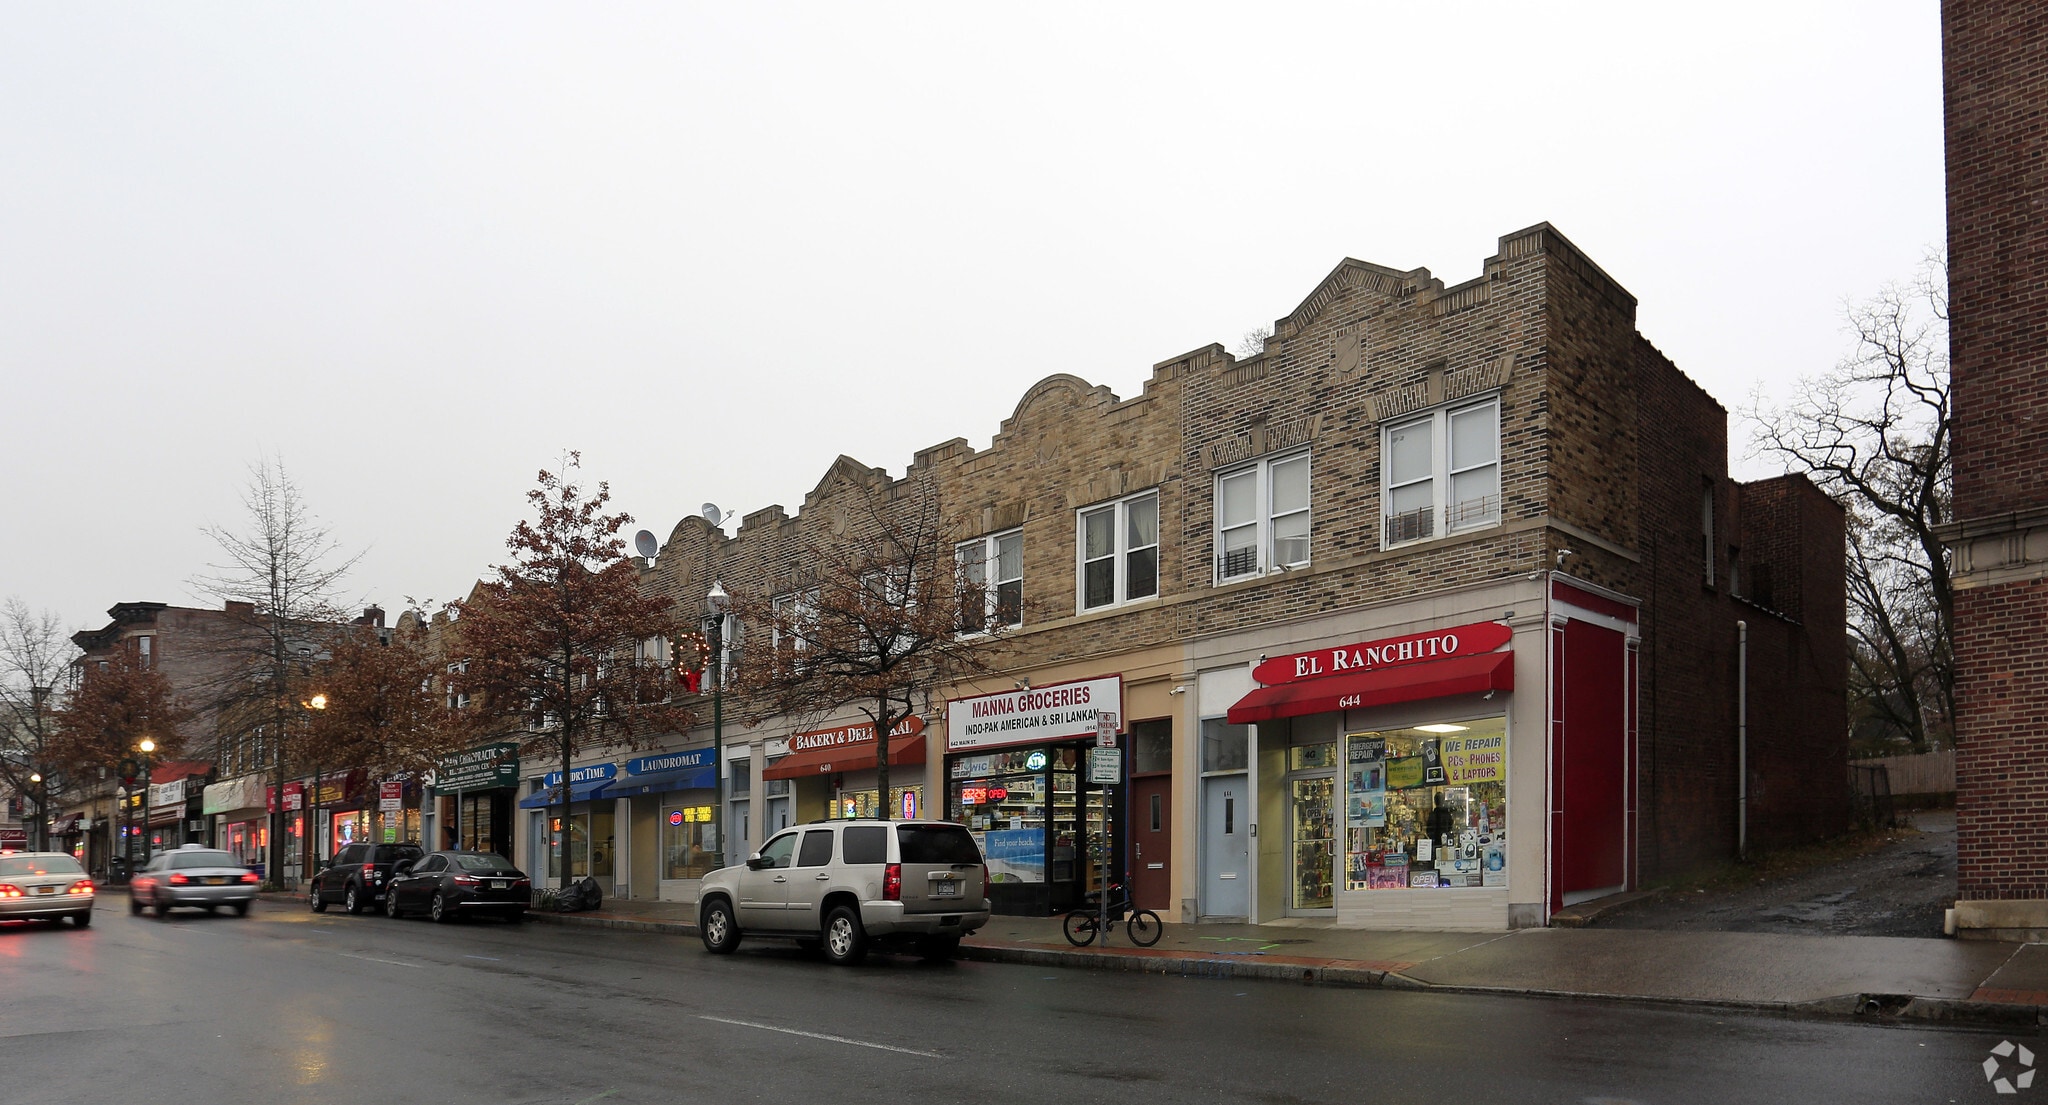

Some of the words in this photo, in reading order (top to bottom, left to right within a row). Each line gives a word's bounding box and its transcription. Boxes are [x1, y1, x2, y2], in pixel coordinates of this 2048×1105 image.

[1294, 655, 1323, 677] EL
[1332, 634, 1459, 671] RANCHITO
[972, 698, 1015, 719] MANNA
[1018, 686, 1091, 713] GROCERIES
[1339, 694, 1361, 708] 644
[965, 720, 999, 736] INDO-PAK
[1001, 715, 1042, 732] AMERICAN
[1043, 715, 1048, 725] &
[1050, 713, 1064, 725] SRI
[1066, 708, 1099, 723] LANKAN
[1098, 721, 1115, 729] PARKING
[796, 732, 836, 750] BAKERY
[837, 730, 845, 744] &
[847, 727, 874, 743] DELI
[1445, 740, 1461, 752] WE
[1465, 737, 1501, 750] REPAIR
[1350, 740, 1385, 751] EMERGENCY
[1304, 750, 1316, 758] 4G
[1350, 749, 1374, 760] REPAIR
[1470, 752, 1501, 765] PHONES
[640, 754, 702, 772] LAUNDROMAT
[820, 763, 832, 772] 640
[971, 762, 988, 772] WIC
[1026, 755, 1047, 768] ATM
[552, 769, 585, 785] LADRY
[584, 767, 606, 780] TIME
[1453, 770, 1459, 781] &
[1463, 767, 1496, 780] LAPTOPS
[988, 789, 1006, 799] OPEN
[1306, 809, 1321, 818] OPEN
[994, 837, 1006, 847] Find
[1006, 839, 1018, 850] your
[1412, 874, 1437, 885] OPEN
